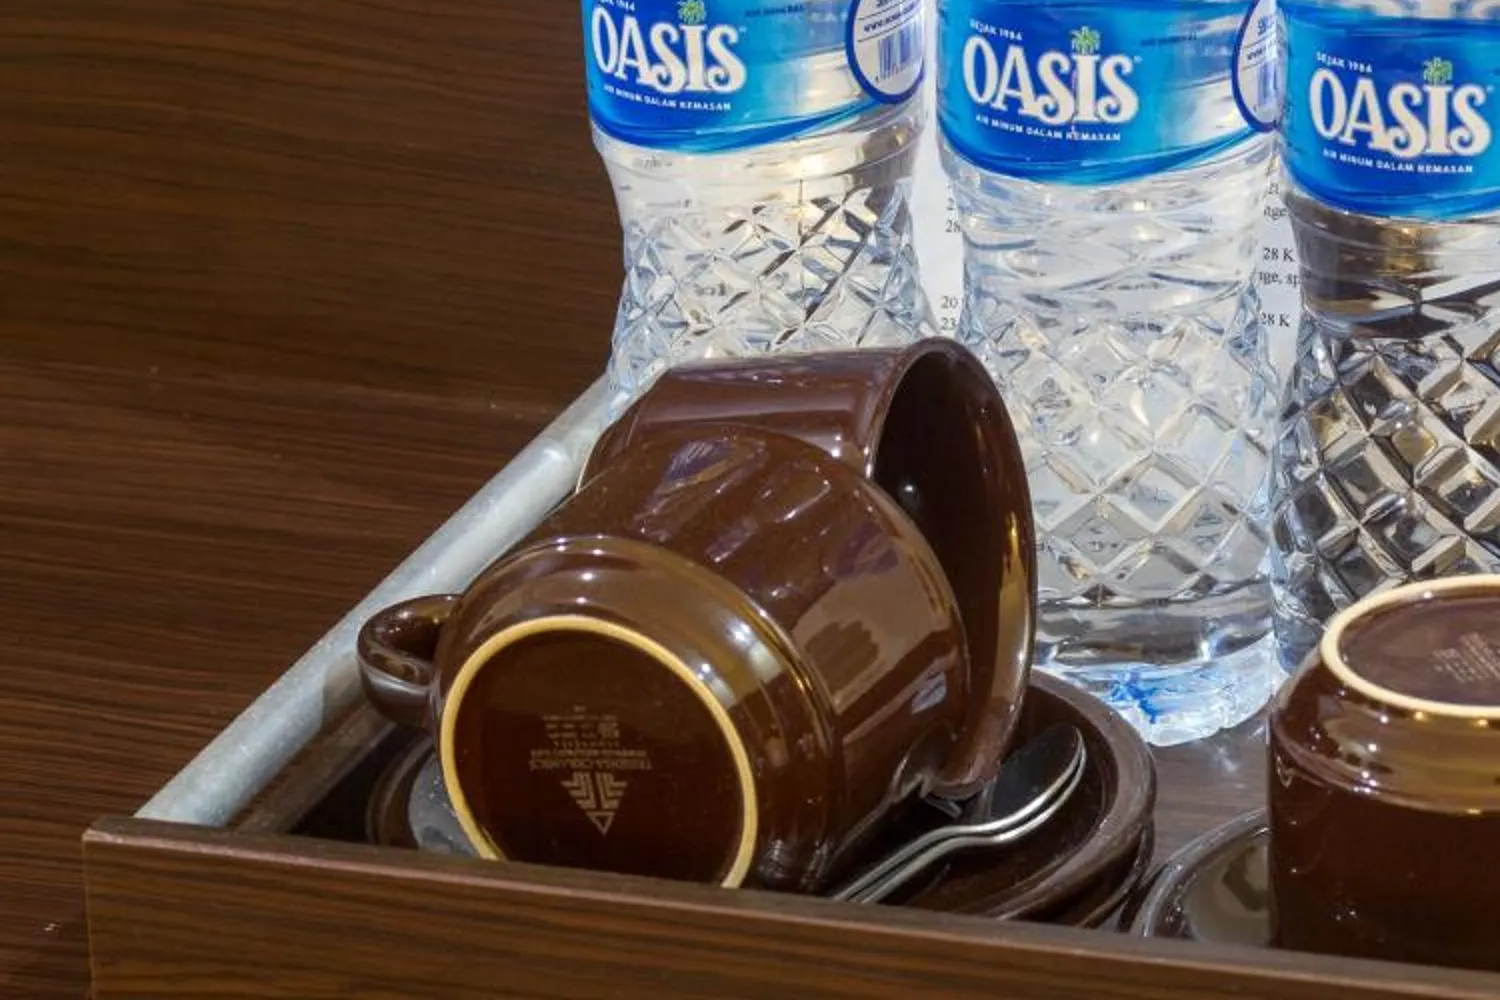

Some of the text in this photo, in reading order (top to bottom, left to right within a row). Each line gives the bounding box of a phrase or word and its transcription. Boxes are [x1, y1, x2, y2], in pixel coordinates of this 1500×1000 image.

[591, 5, 747, 94] OASIS
[1316, 50, 1346, 68] SEJAK
[962, 34, 1140, 126] OASIS
[1309, 67, 1492, 159] OASIS
[1339, 152, 1374, 169] MINUM
[1376, 159, 1414, 173] DALAM
[1263, 247, 1296, 263] 28 K
